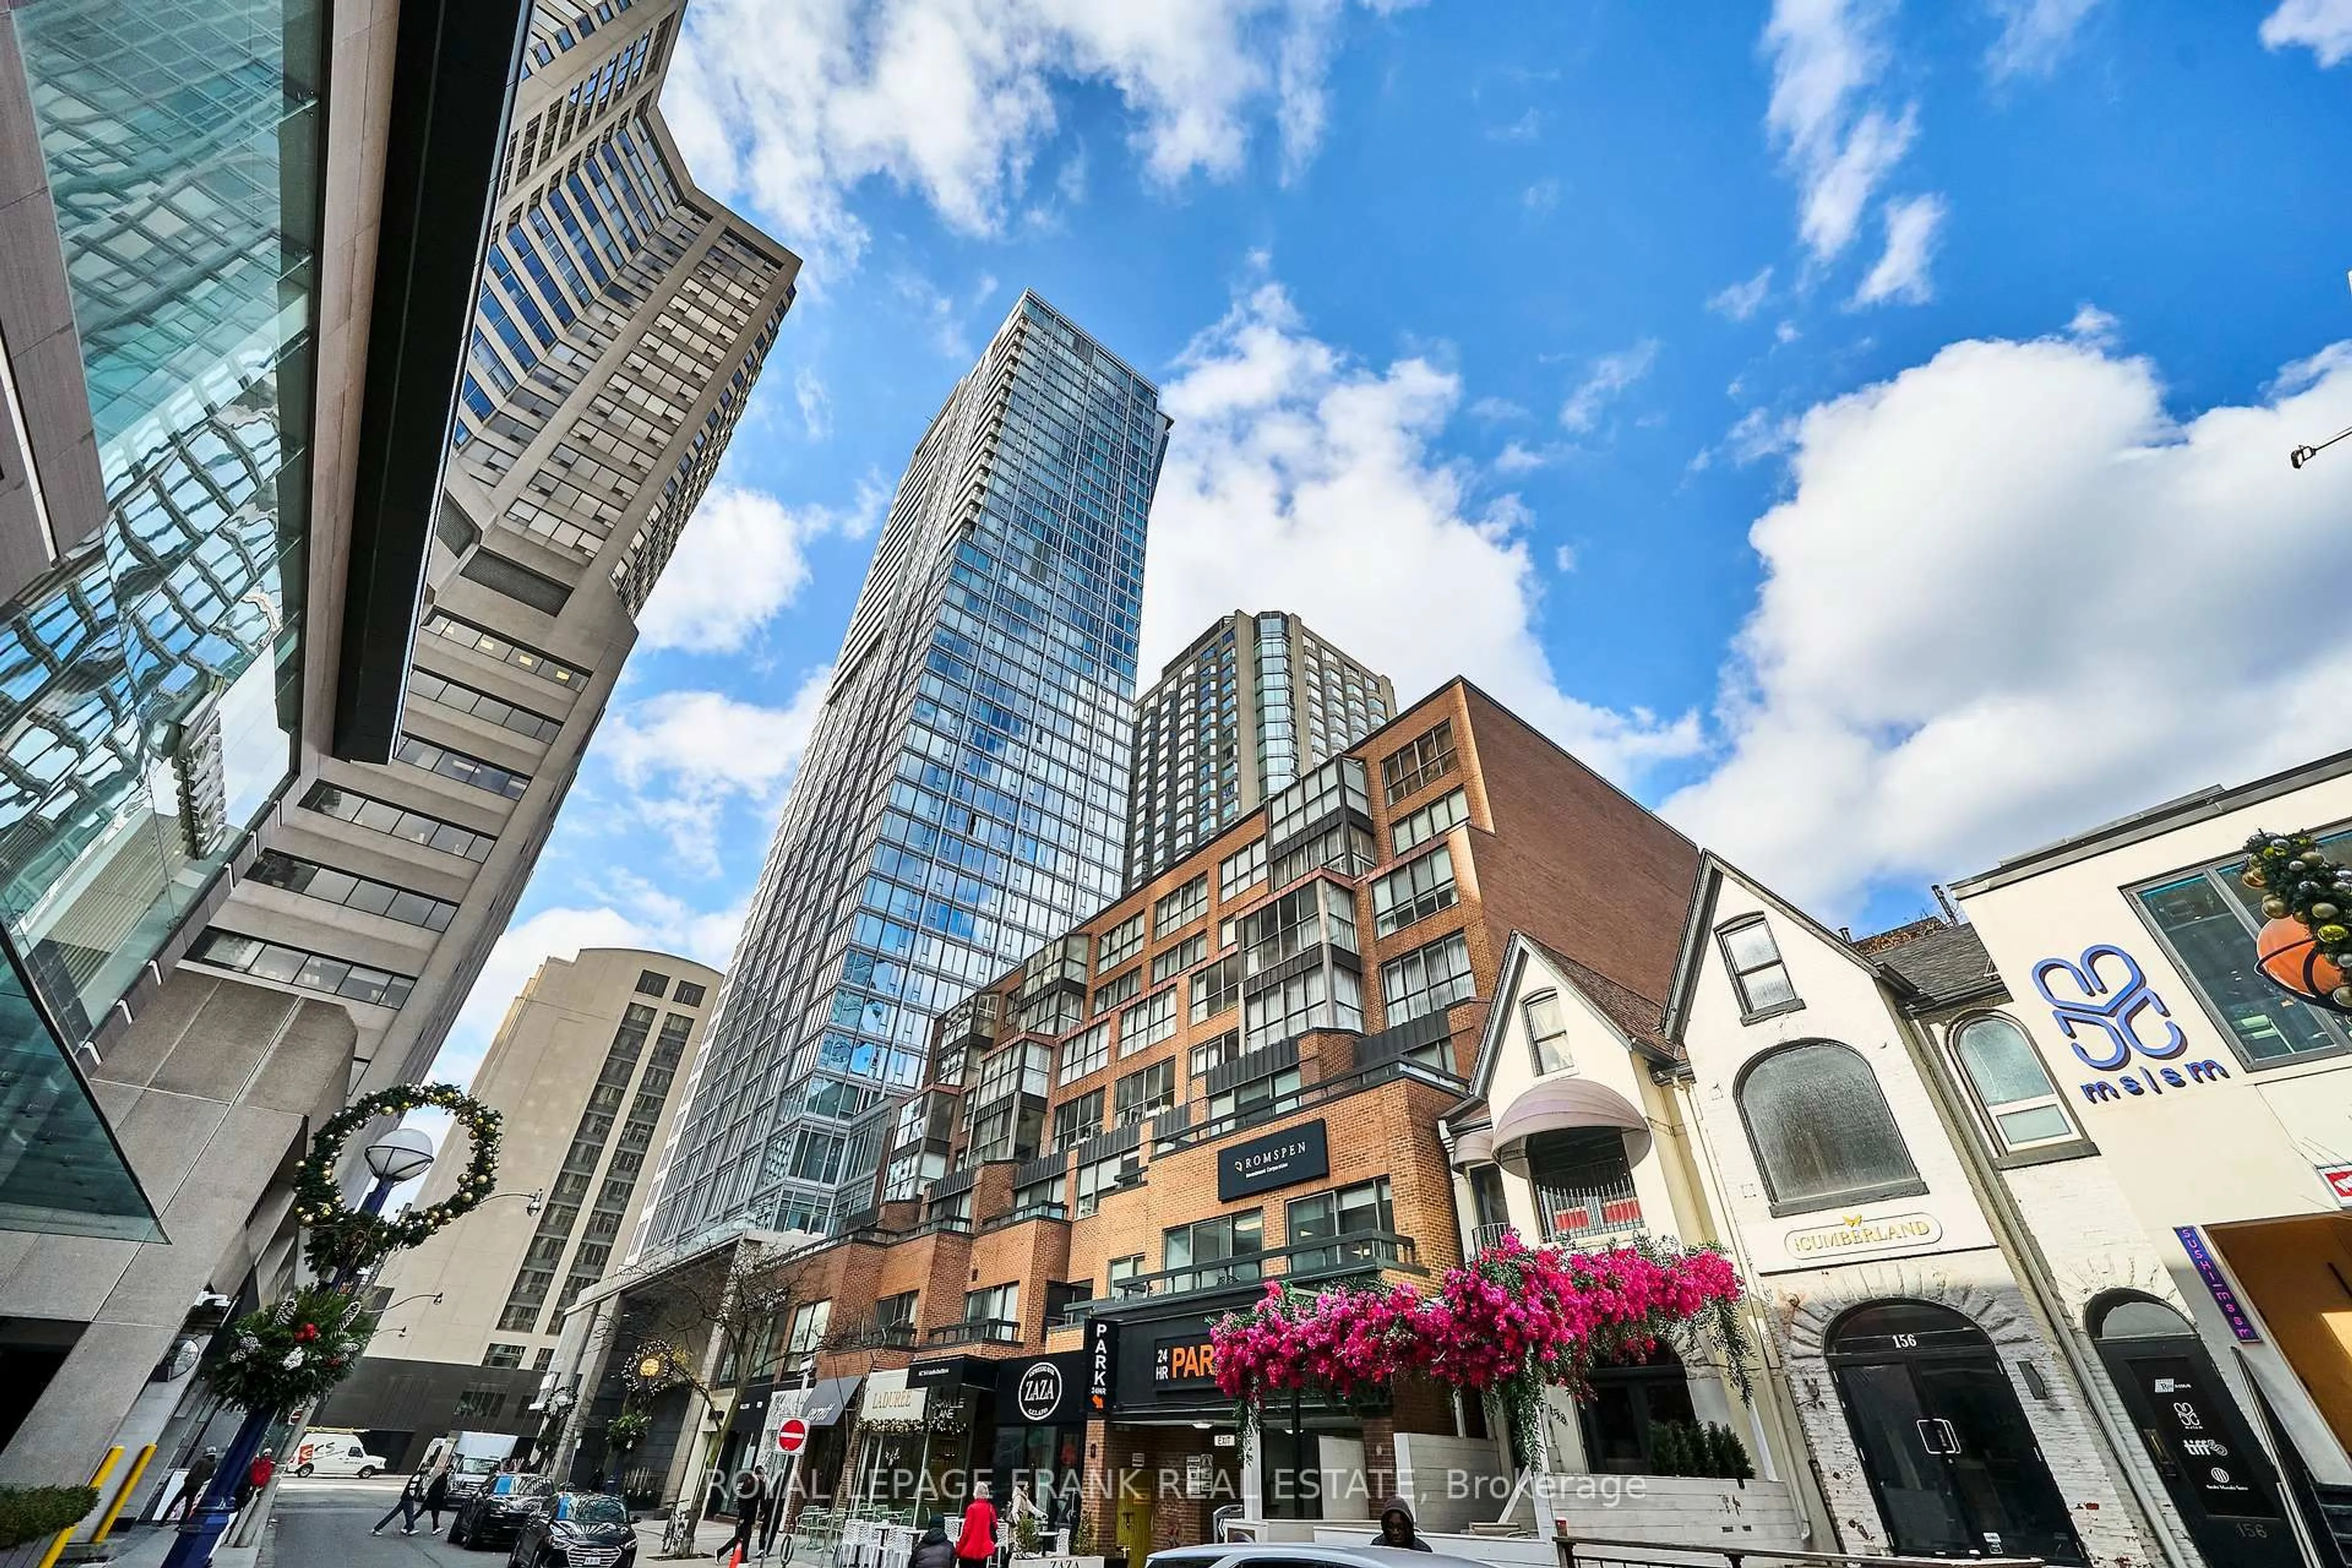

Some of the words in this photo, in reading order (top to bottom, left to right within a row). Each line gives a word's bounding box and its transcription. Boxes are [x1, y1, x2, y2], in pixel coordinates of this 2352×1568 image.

[1245, 1141, 1306, 1169] ROMSPEN
[1798, 1221, 1930, 1251] CUMBERLAND
[1893, 1334, 1917, 1348] 156
[1094, 1324, 1107, 1385] PARK
[1157, 1349, 1168, 1363] 24
[1156, 1366, 1169, 1381] HR
[1024, 1379, 1054, 1401] ZAZA
